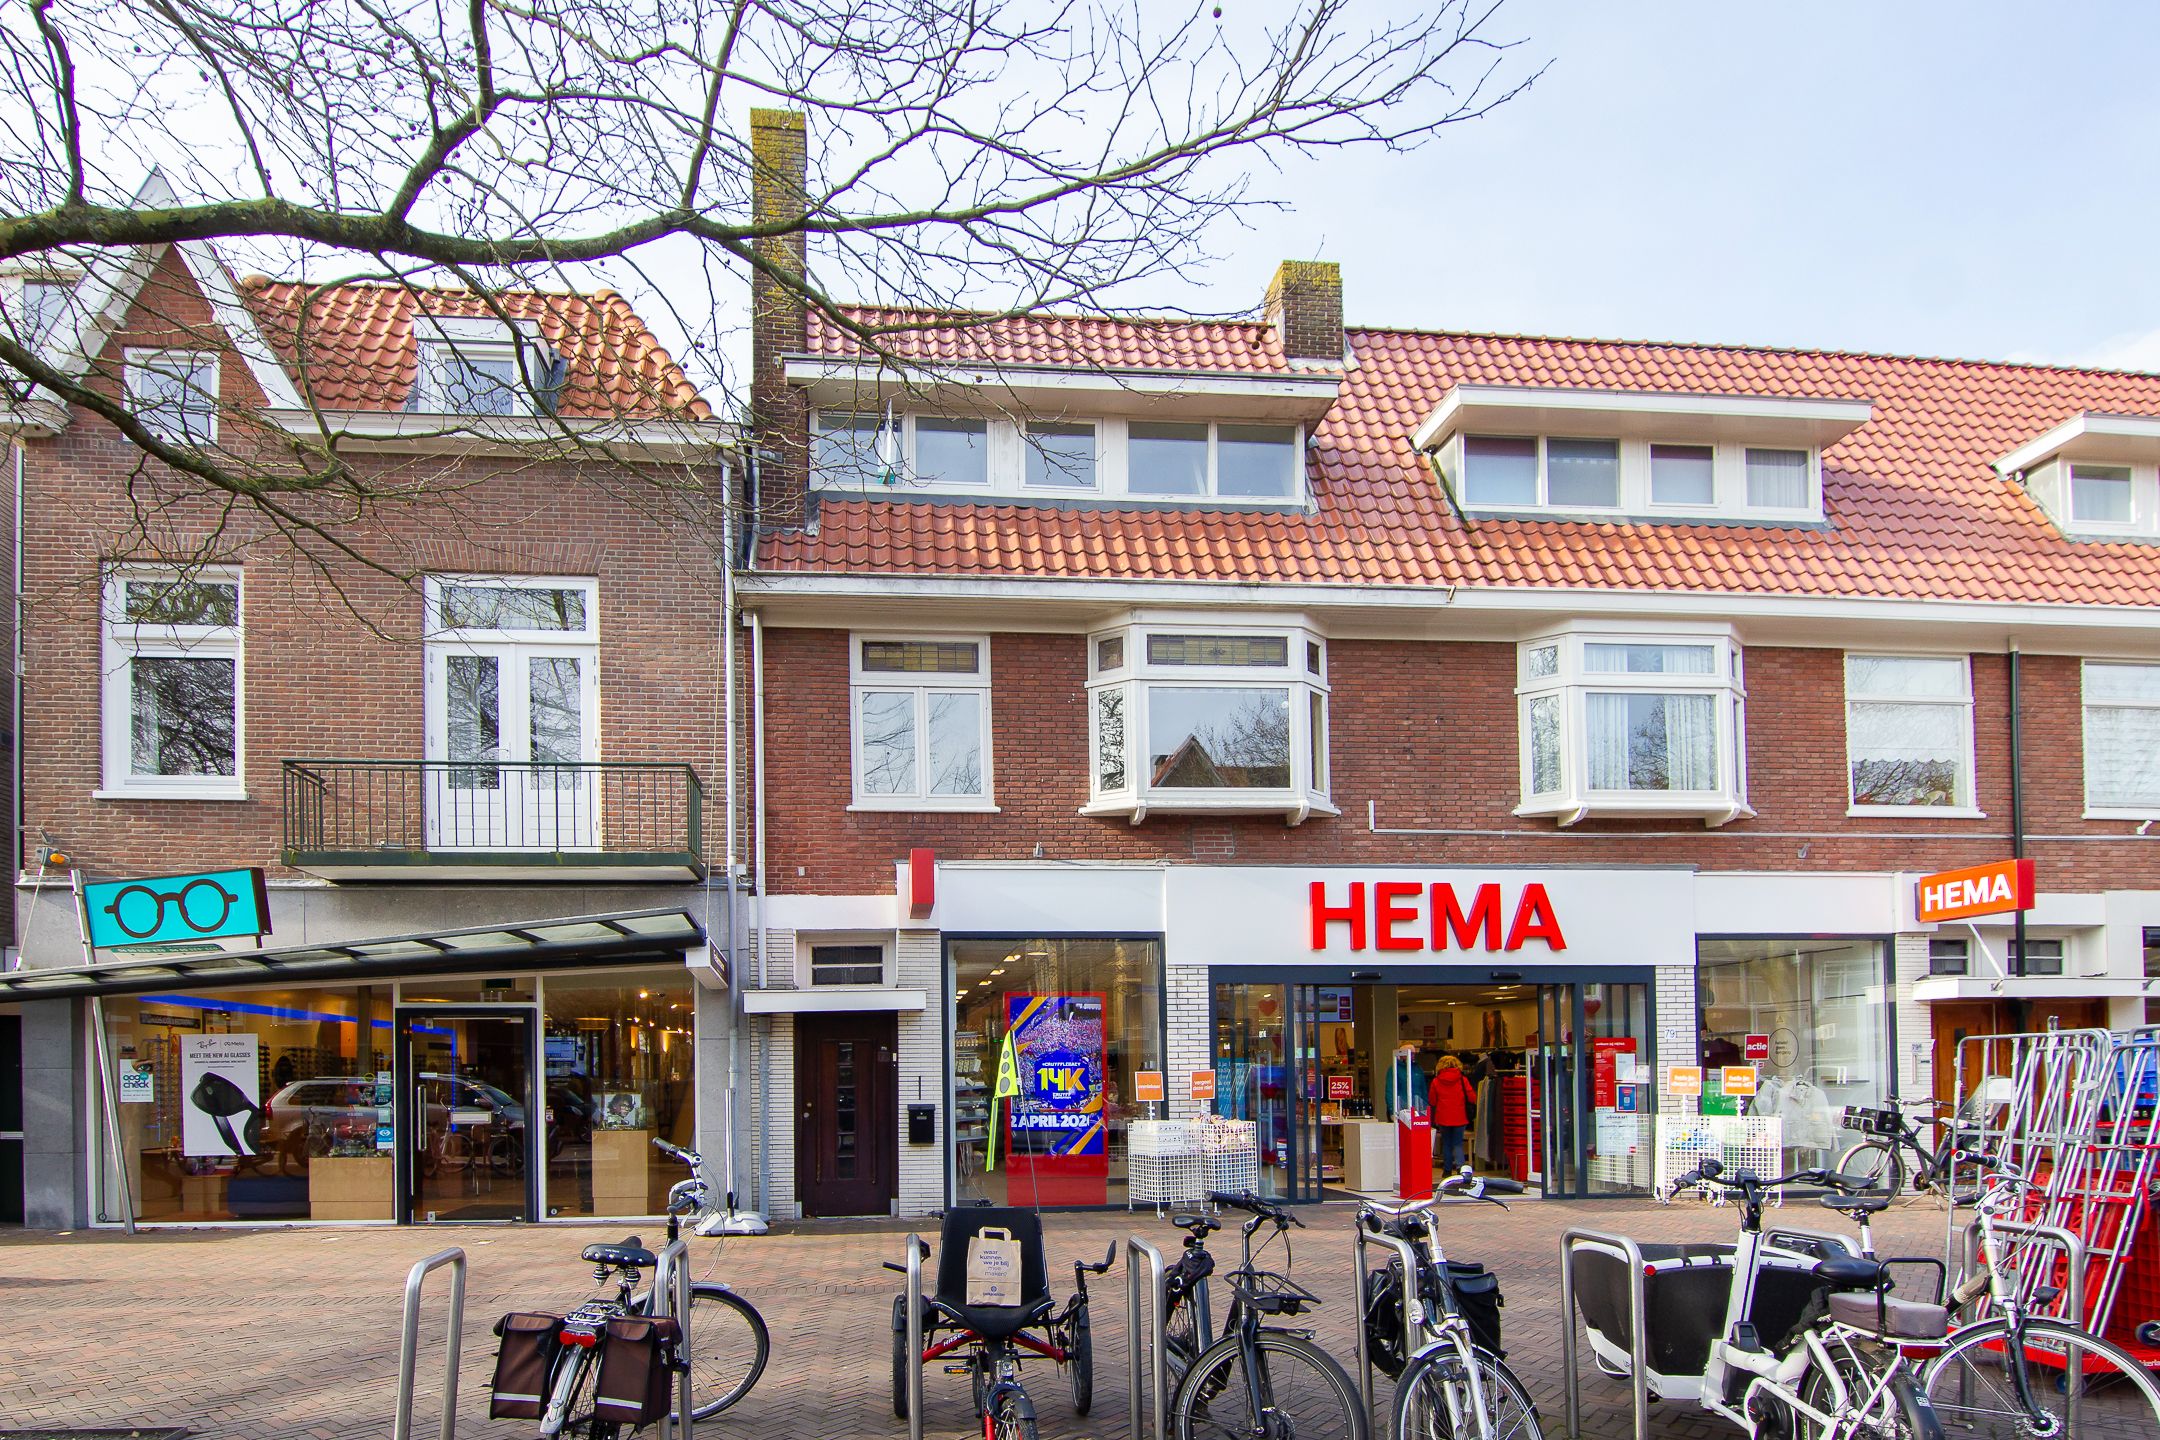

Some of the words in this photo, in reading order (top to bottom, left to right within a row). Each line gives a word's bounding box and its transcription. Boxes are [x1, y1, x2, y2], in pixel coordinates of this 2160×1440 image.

[1925, 874, 2012, 912] HEMA
[1309, 882, 1567, 952] HEMA
[1665, 1029, 1675, 1038] 79
[1747, 1043, 1767, 1051] actie
[123, 1074, 141, 1082] oog
[1036, 1068, 1086, 1091] 14K
[123, 1079, 149, 1088] check
[1332, 1082, 1349, 1090] 25%
[1018, 1115, 1060, 1127] APRIL
